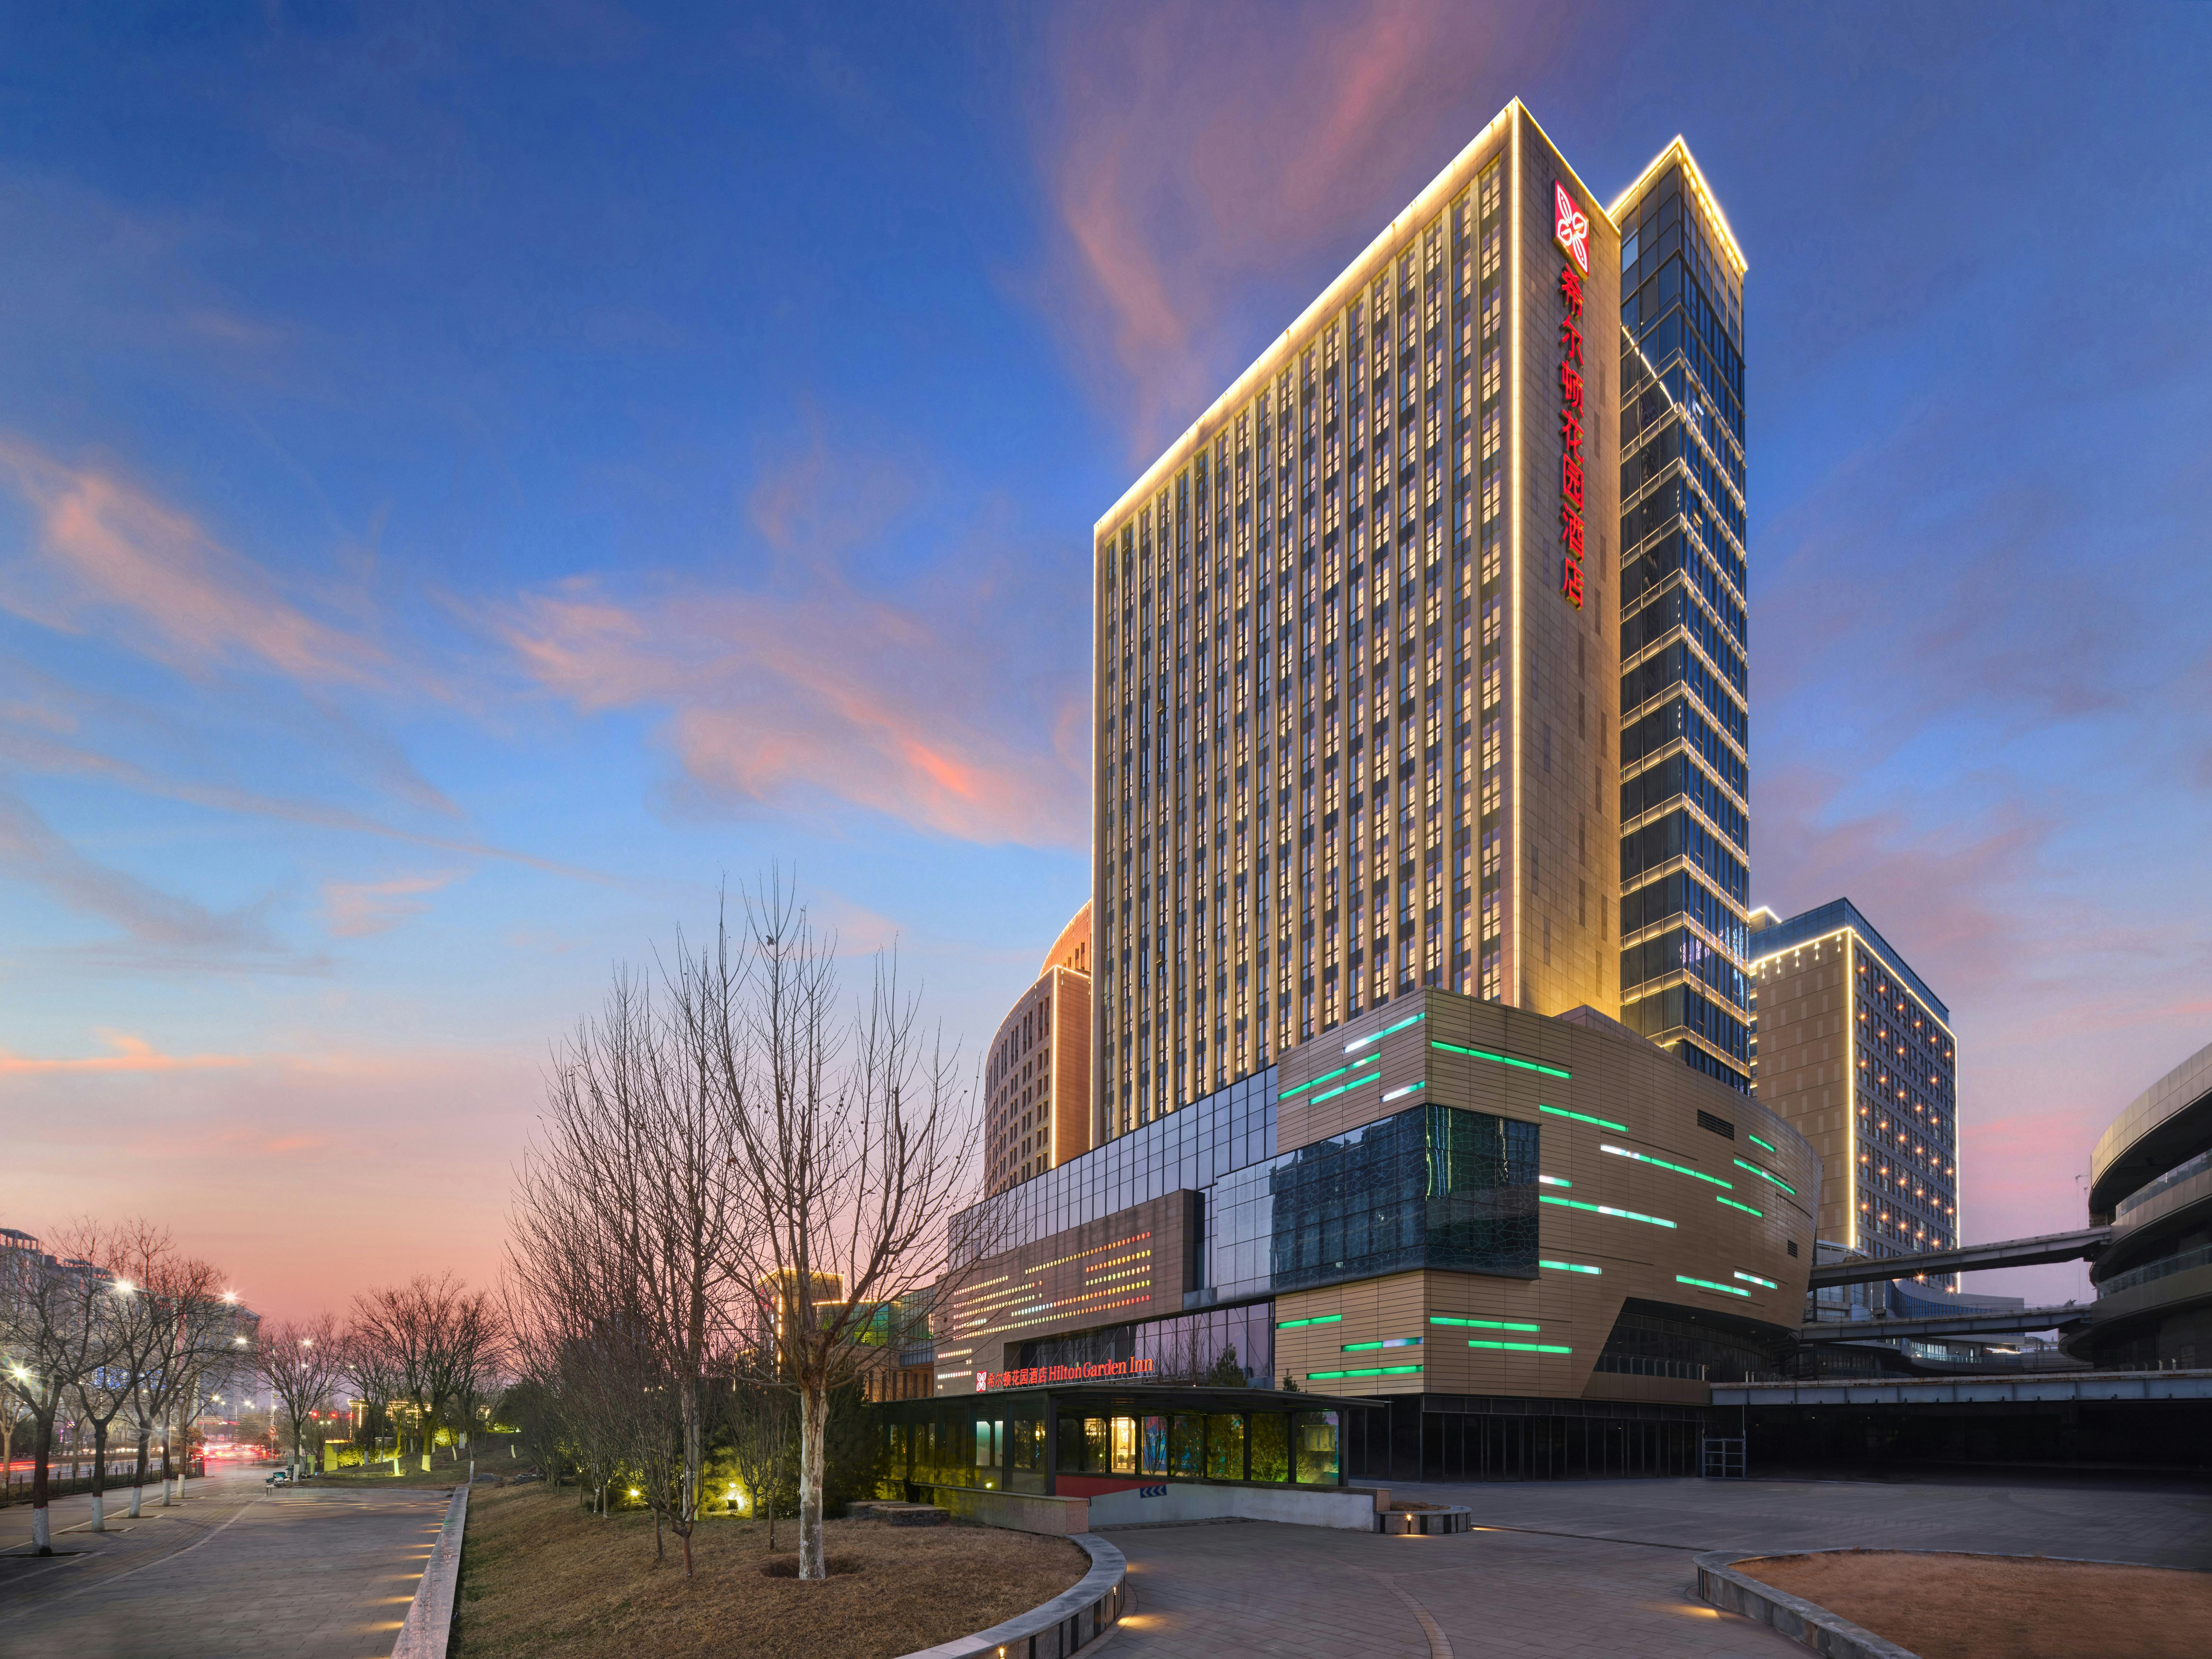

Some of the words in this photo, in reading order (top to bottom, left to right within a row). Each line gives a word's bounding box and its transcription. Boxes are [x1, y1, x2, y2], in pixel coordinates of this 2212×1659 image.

[1561, 263, 1584, 609] 希尔顿花园酒店
[988, 1366, 1047, 1388] 希尔顿花园酒店
[1048, 1365, 1082, 1381] Hilton
[1083, 1359, 1127, 1377] Garden
[1129, 1356, 1153, 1373] Inn
